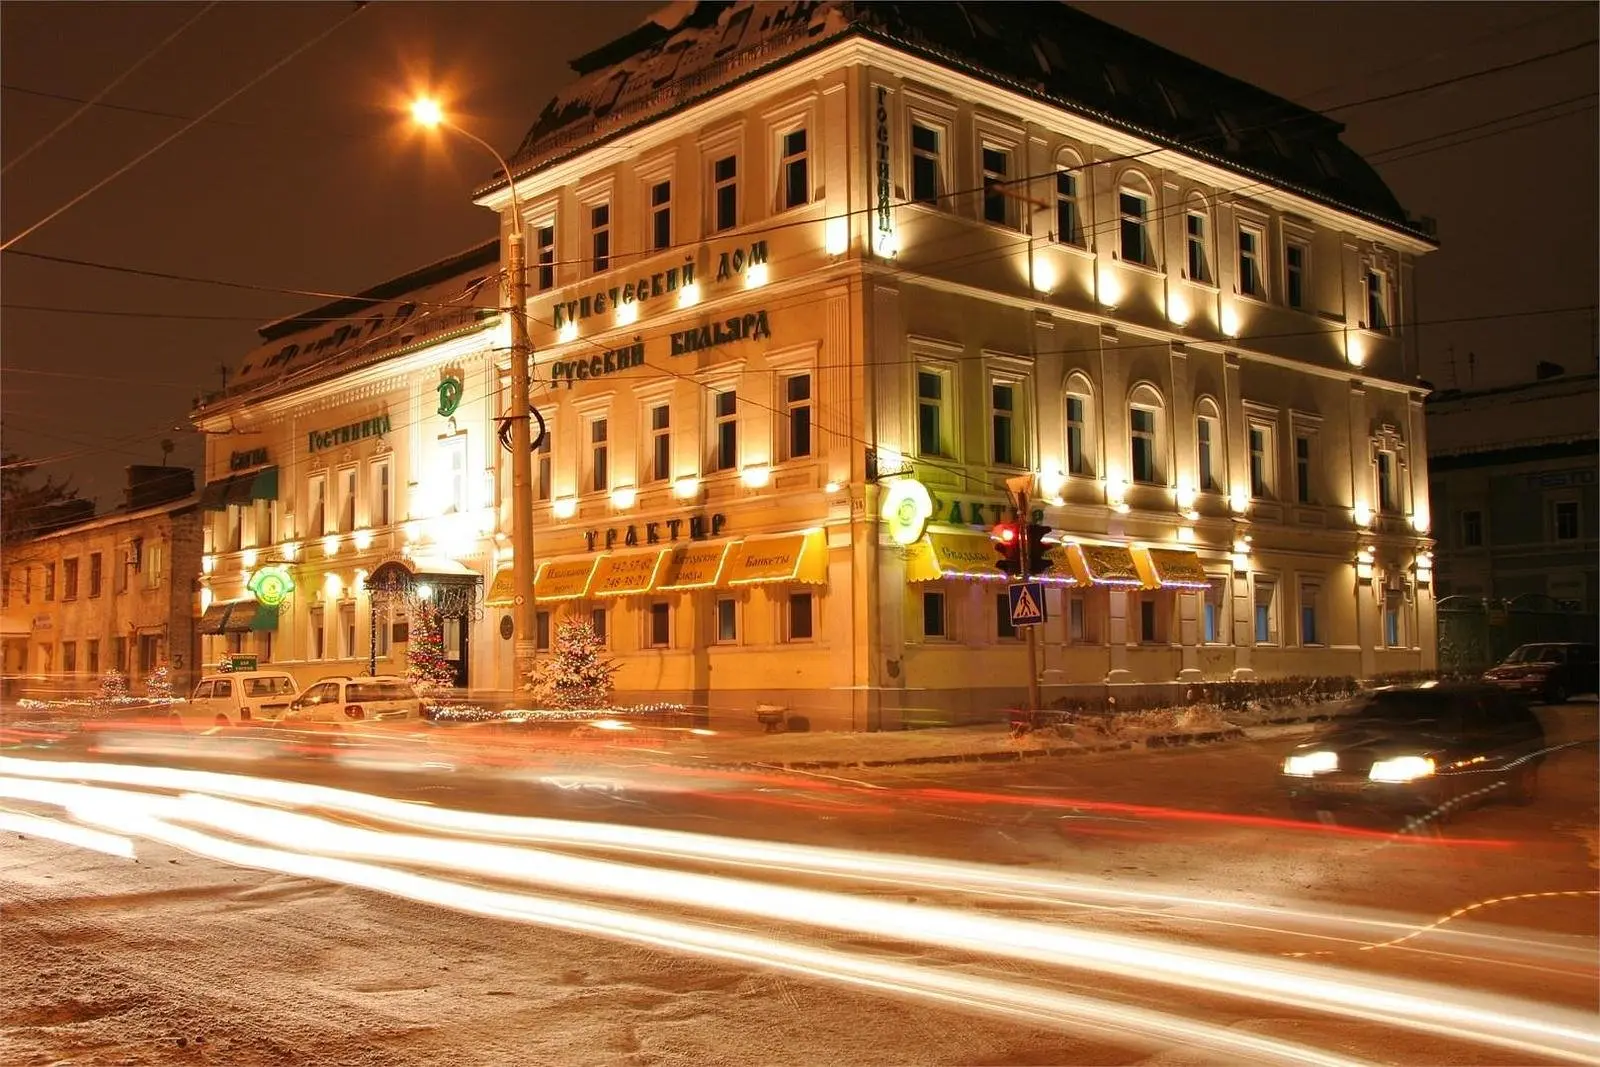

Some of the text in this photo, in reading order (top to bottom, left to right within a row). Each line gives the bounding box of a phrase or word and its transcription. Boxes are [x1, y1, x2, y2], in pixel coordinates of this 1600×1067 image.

[716, 240, 768, 282] ДОМ
[584, 513, 726, 551] ТРАКТИР
[745, 554, 790, 568] Банкеты
